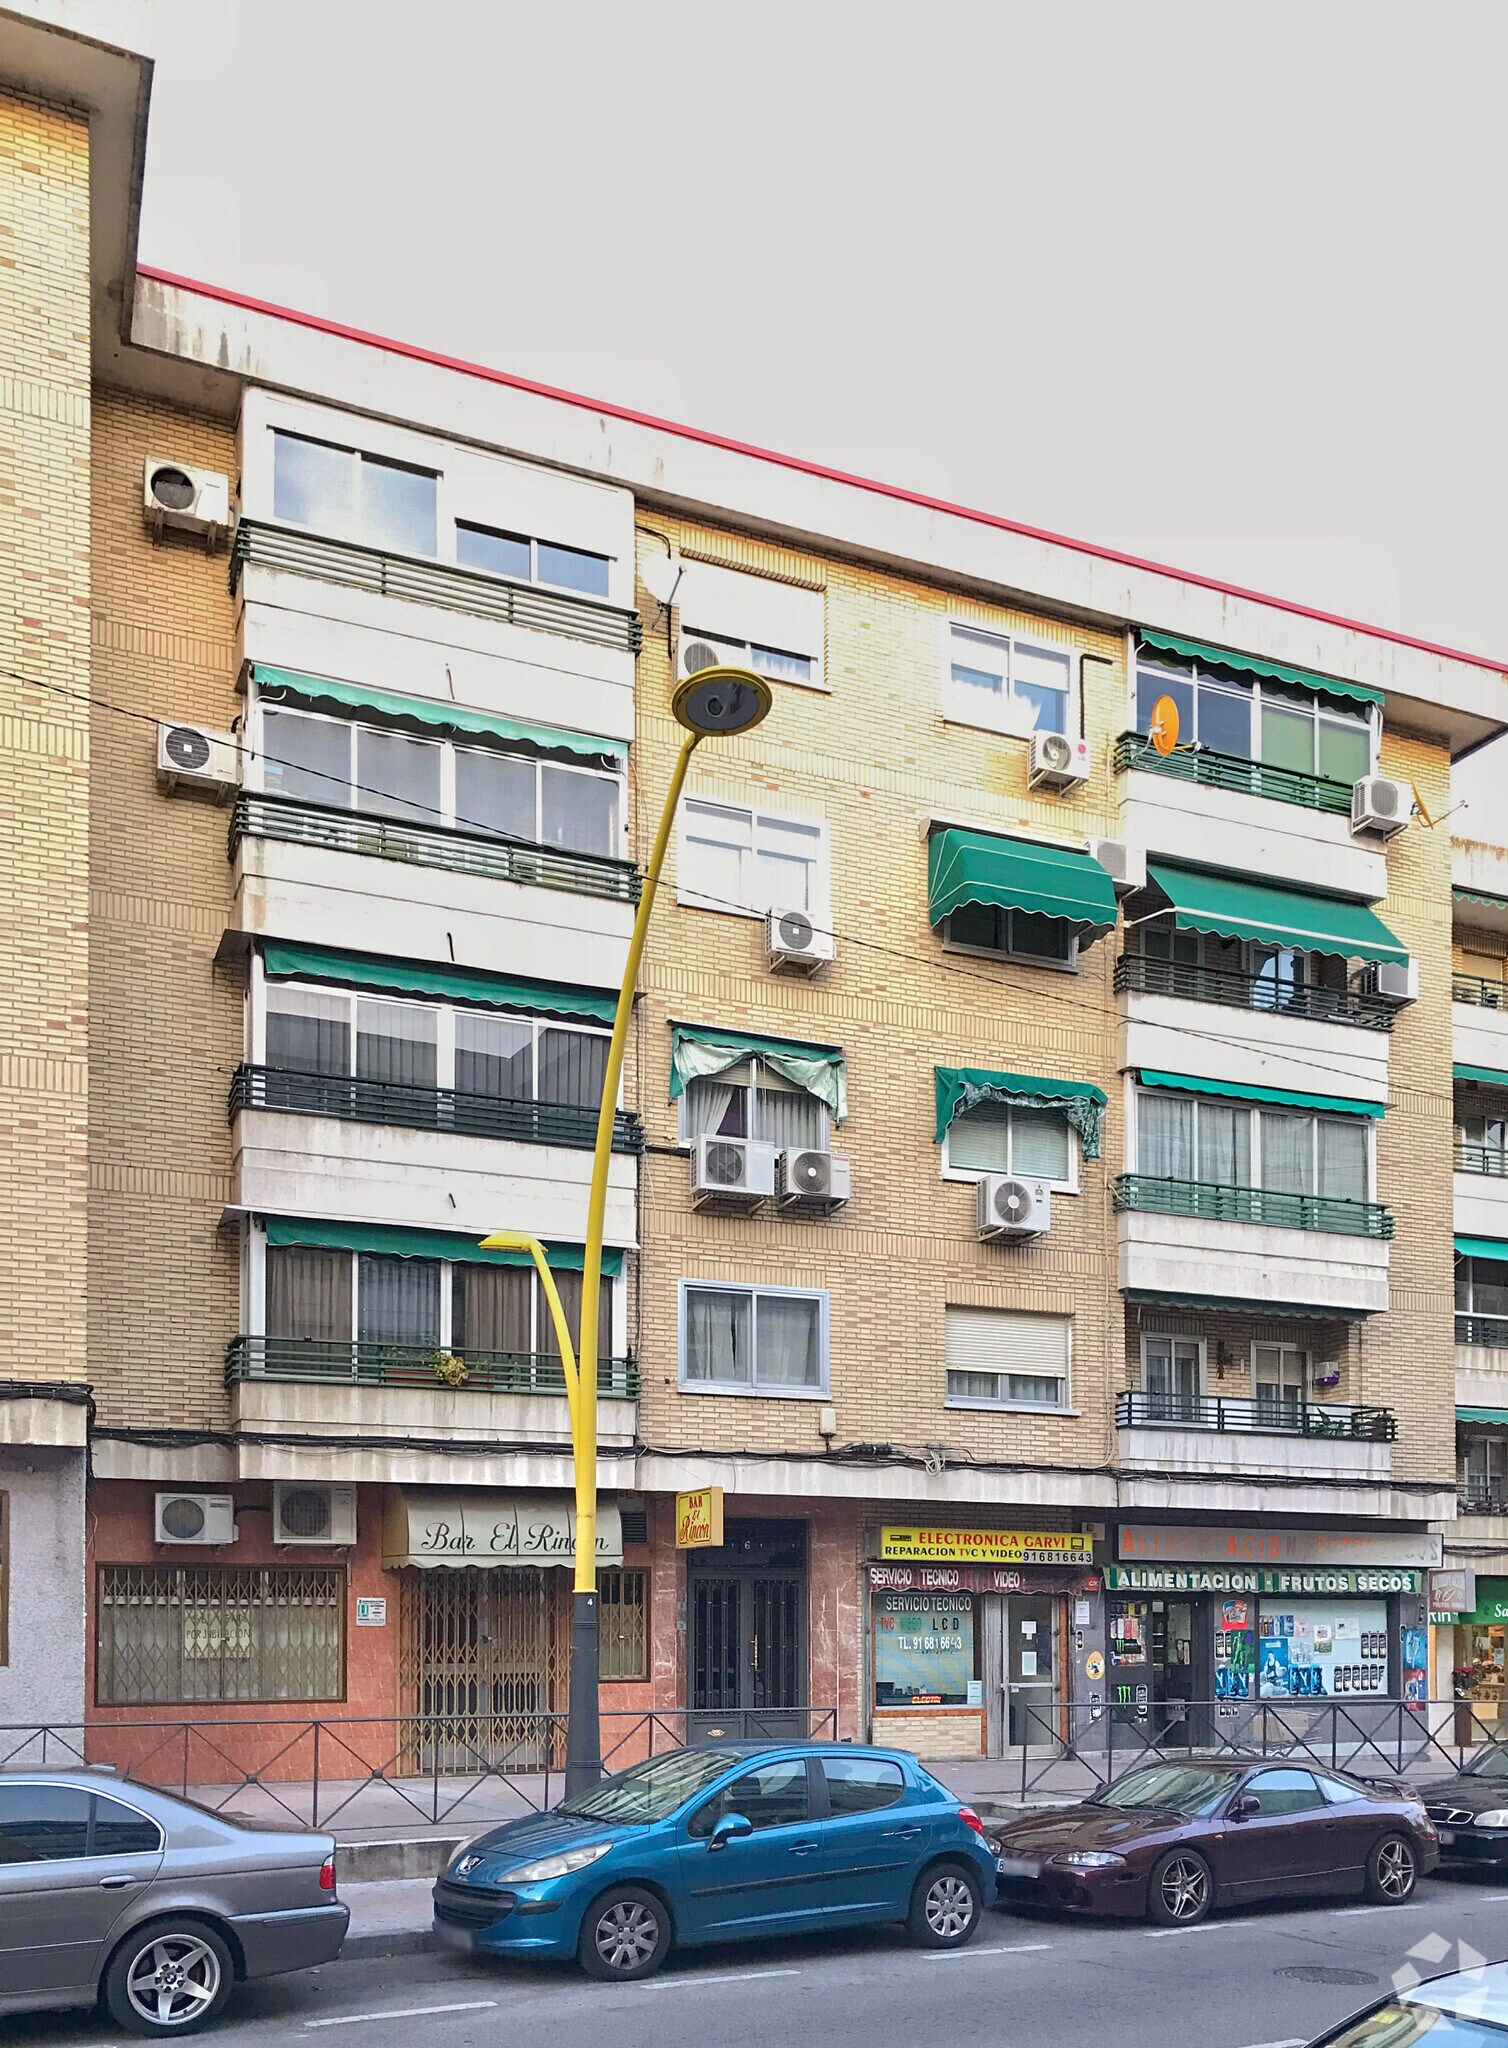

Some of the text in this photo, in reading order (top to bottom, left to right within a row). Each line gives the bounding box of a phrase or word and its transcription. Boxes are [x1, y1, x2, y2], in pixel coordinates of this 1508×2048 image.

[689, 1495, 703, 1509] BAR
[421, 1521, 609, 1552] Bar El Rincn
[918, 1532, 1066, 1549] ELECTRONICA GARVI
[744, 1540, 751, 1551] 6
[884, 1546, 1093, 1563] REPARACION TVC Y VIDEO 916816643
[870, 1567, 1020, 1588] SERVICIO TECNICO VIDEO
[1117, 1570, 1257, 1590] ALIMENTACION
[1281, 1575, 1349, 1591] FRUTOS
[1357, 1576, 1412, 1592] SECOS
[886, 1596, 972, 1612] SERVICIO TECNICO
[880, 1616, 895, 1631] TVC
[913, 1636, 923, 1650] 91
[924, 1636, 939, 1650] 681
[940, 1636, 962, 1651] 6643
